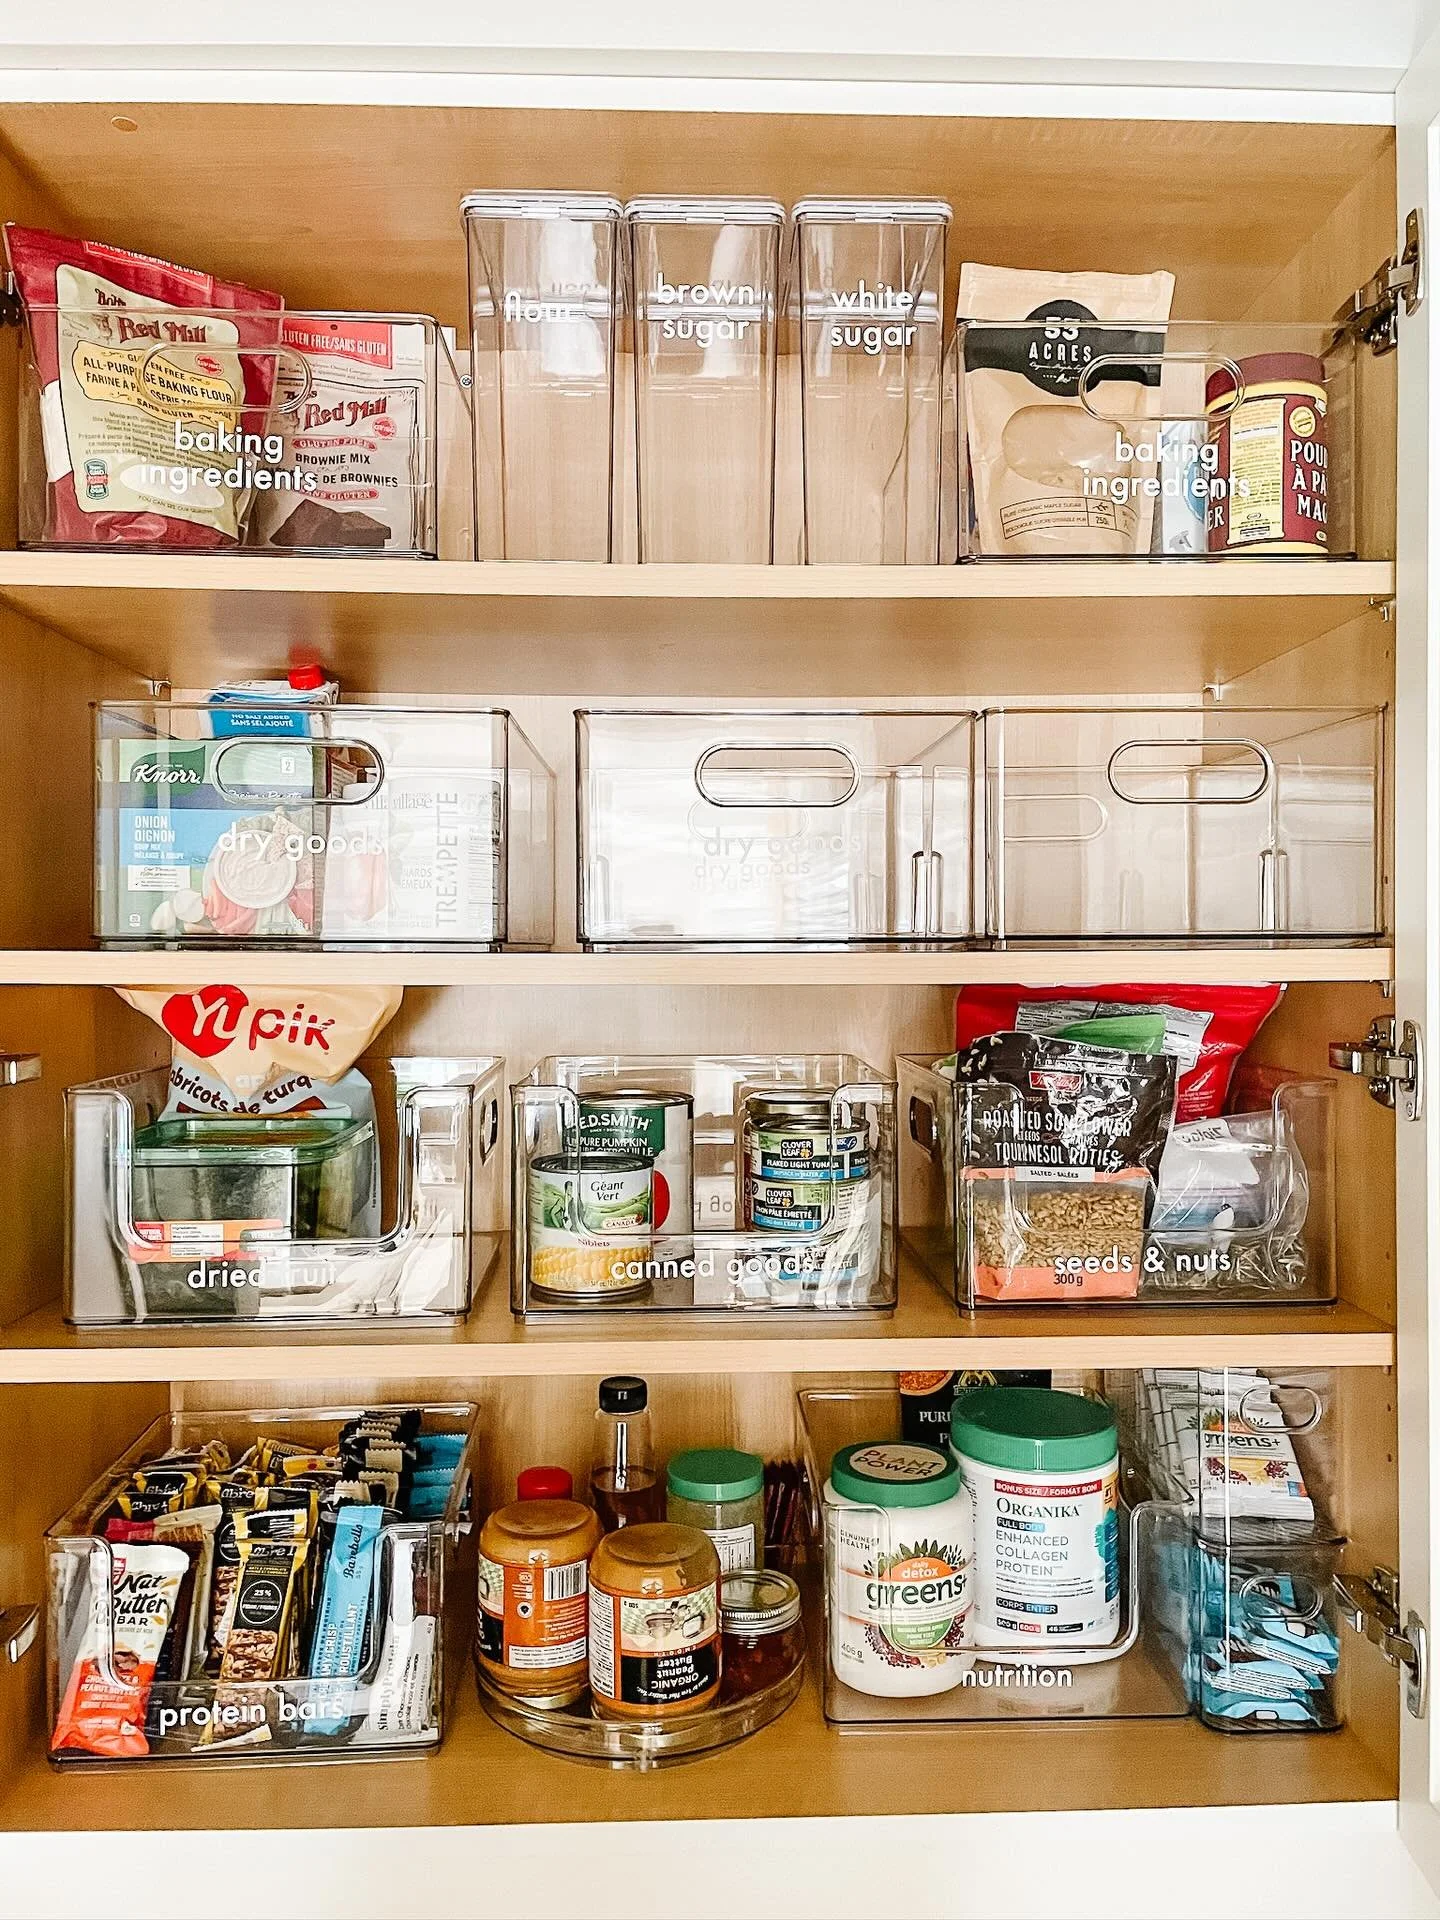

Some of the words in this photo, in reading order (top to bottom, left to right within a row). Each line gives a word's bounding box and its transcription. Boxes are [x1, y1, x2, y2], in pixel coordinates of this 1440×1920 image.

[657, 272, 754, 304] brown
[831, 279, 914, 311] white
[116, 316, 161, 343] Red
[162, 321, 207, 343] Mill
[662, 318, 750, 348] sugar
[357, 338, 387, 356] GLUTEN
[830, 323, 918, 355] sugar
[1028, 341, 1092, 363] ACRES
[86, 371, 120, 389] FARINE
[164, 367, 186, 381] FREE
[159, 373, 198, 397] BAKING
[200, 387, 232, 405] FLOUR
[304, 401, 345, 431] Red
[345, 396, 386, 427] Mill
[174, 419, 284, 464] baking
[301, 438, 340, 449] GLUTEN
[295, 453, 346, 466] BROWNIE
[350, 453, 370, 465] MIX
[1115, 430, 1219, 474] baking
[140, 456, 317, 495] ingredients
[323, 474, 336, 484] DE
[341, 473, 398, 488] BROWNIES
[1292, 464, 1307, 491] À
[330, 489, 371, 500] GLUTEN
[1083, 468, 1251, 505] ingredients
[230, 719, 250, 727] SANS
[251, 719, 264, 727] SEL
[264, 719, 295, 727] AJOUTÉ
[132, 762, 201, 785] Knorr
[134, 815, 169, 829] ONION
[134, 830, 176, 843] OIGNON
[219, 821, 273, 861] dry
[285, 826, 384, 862] goods
[704, 826, 754, 864] dry
[435, 792, 458, 928] TREMPETTE
[191, 992, 336, 1051] Yupik
[580, 1137, 601, 1147] PURE
[601, 1137, 648, 1148] PUMPKIN
[781, 1140, 812, 1149] CLOVER
[782, 1148, 801, 1157] LEAF
[766, 1159, 789, 1167] FLAKED
[790, 1160, 810, 1168] LIGHT
[1030, 1169, 1052, 1177] SALTED
[596, 1191, 619, 1201] Vert
[766, 1189, 792, 1197] CLOVER
[766, 1196, 782, 1205] LEAF
[606, 1220, 635, 1228] CANADA
[1054, 1244, 1134, 1275] seeds
[1143, 1246, 1166, 1273] &
[1176, 1248, 1232, 1273] nuts
[187, 1257, 266, 1289] dried
[610, 1253, 716, 1280] canned
[726, 1253, 816, 1285] goods
[1053, 1273, 1075, 1285] 300
[854, 1456, 932, 1476] POWER
[863, 1449, 943, 1470] PLANT
[996, 1482, 1024, 1494] BONUS
[1024, 1484, 1042, 1496] SIZE
[1051, 1485, 1081, 1497] FORMAT
[998, 1517, 1018, 1529] FULL
[840, 1537, 871, 1551] HEALTH
[996, 1530, 1070, 1547] ENHANCED
[996, 1544, 1069, 1562] COLLAGEN
[901, 1566, 939, 1579] detox
[996, 1559, 1054, 1577] PROTEIN
[114, 1573, 169, 1595] Nut
[997, 1597, 1024, 1611] CORPS
[1026, 1603, 1057, 1613] ENTIER
[117, 1615, 149, 1627] BAR
[657, 1655, 693, 1668] Butter
[656, 1663, 694, 1679] Peanut
[962, 1664, 1073, 1688] nutrition
[651, 1672, 699, 1690] ORGANIC
[159, 1696, 267, 1736] protein
[279, 1692, 344, 1722] bars
